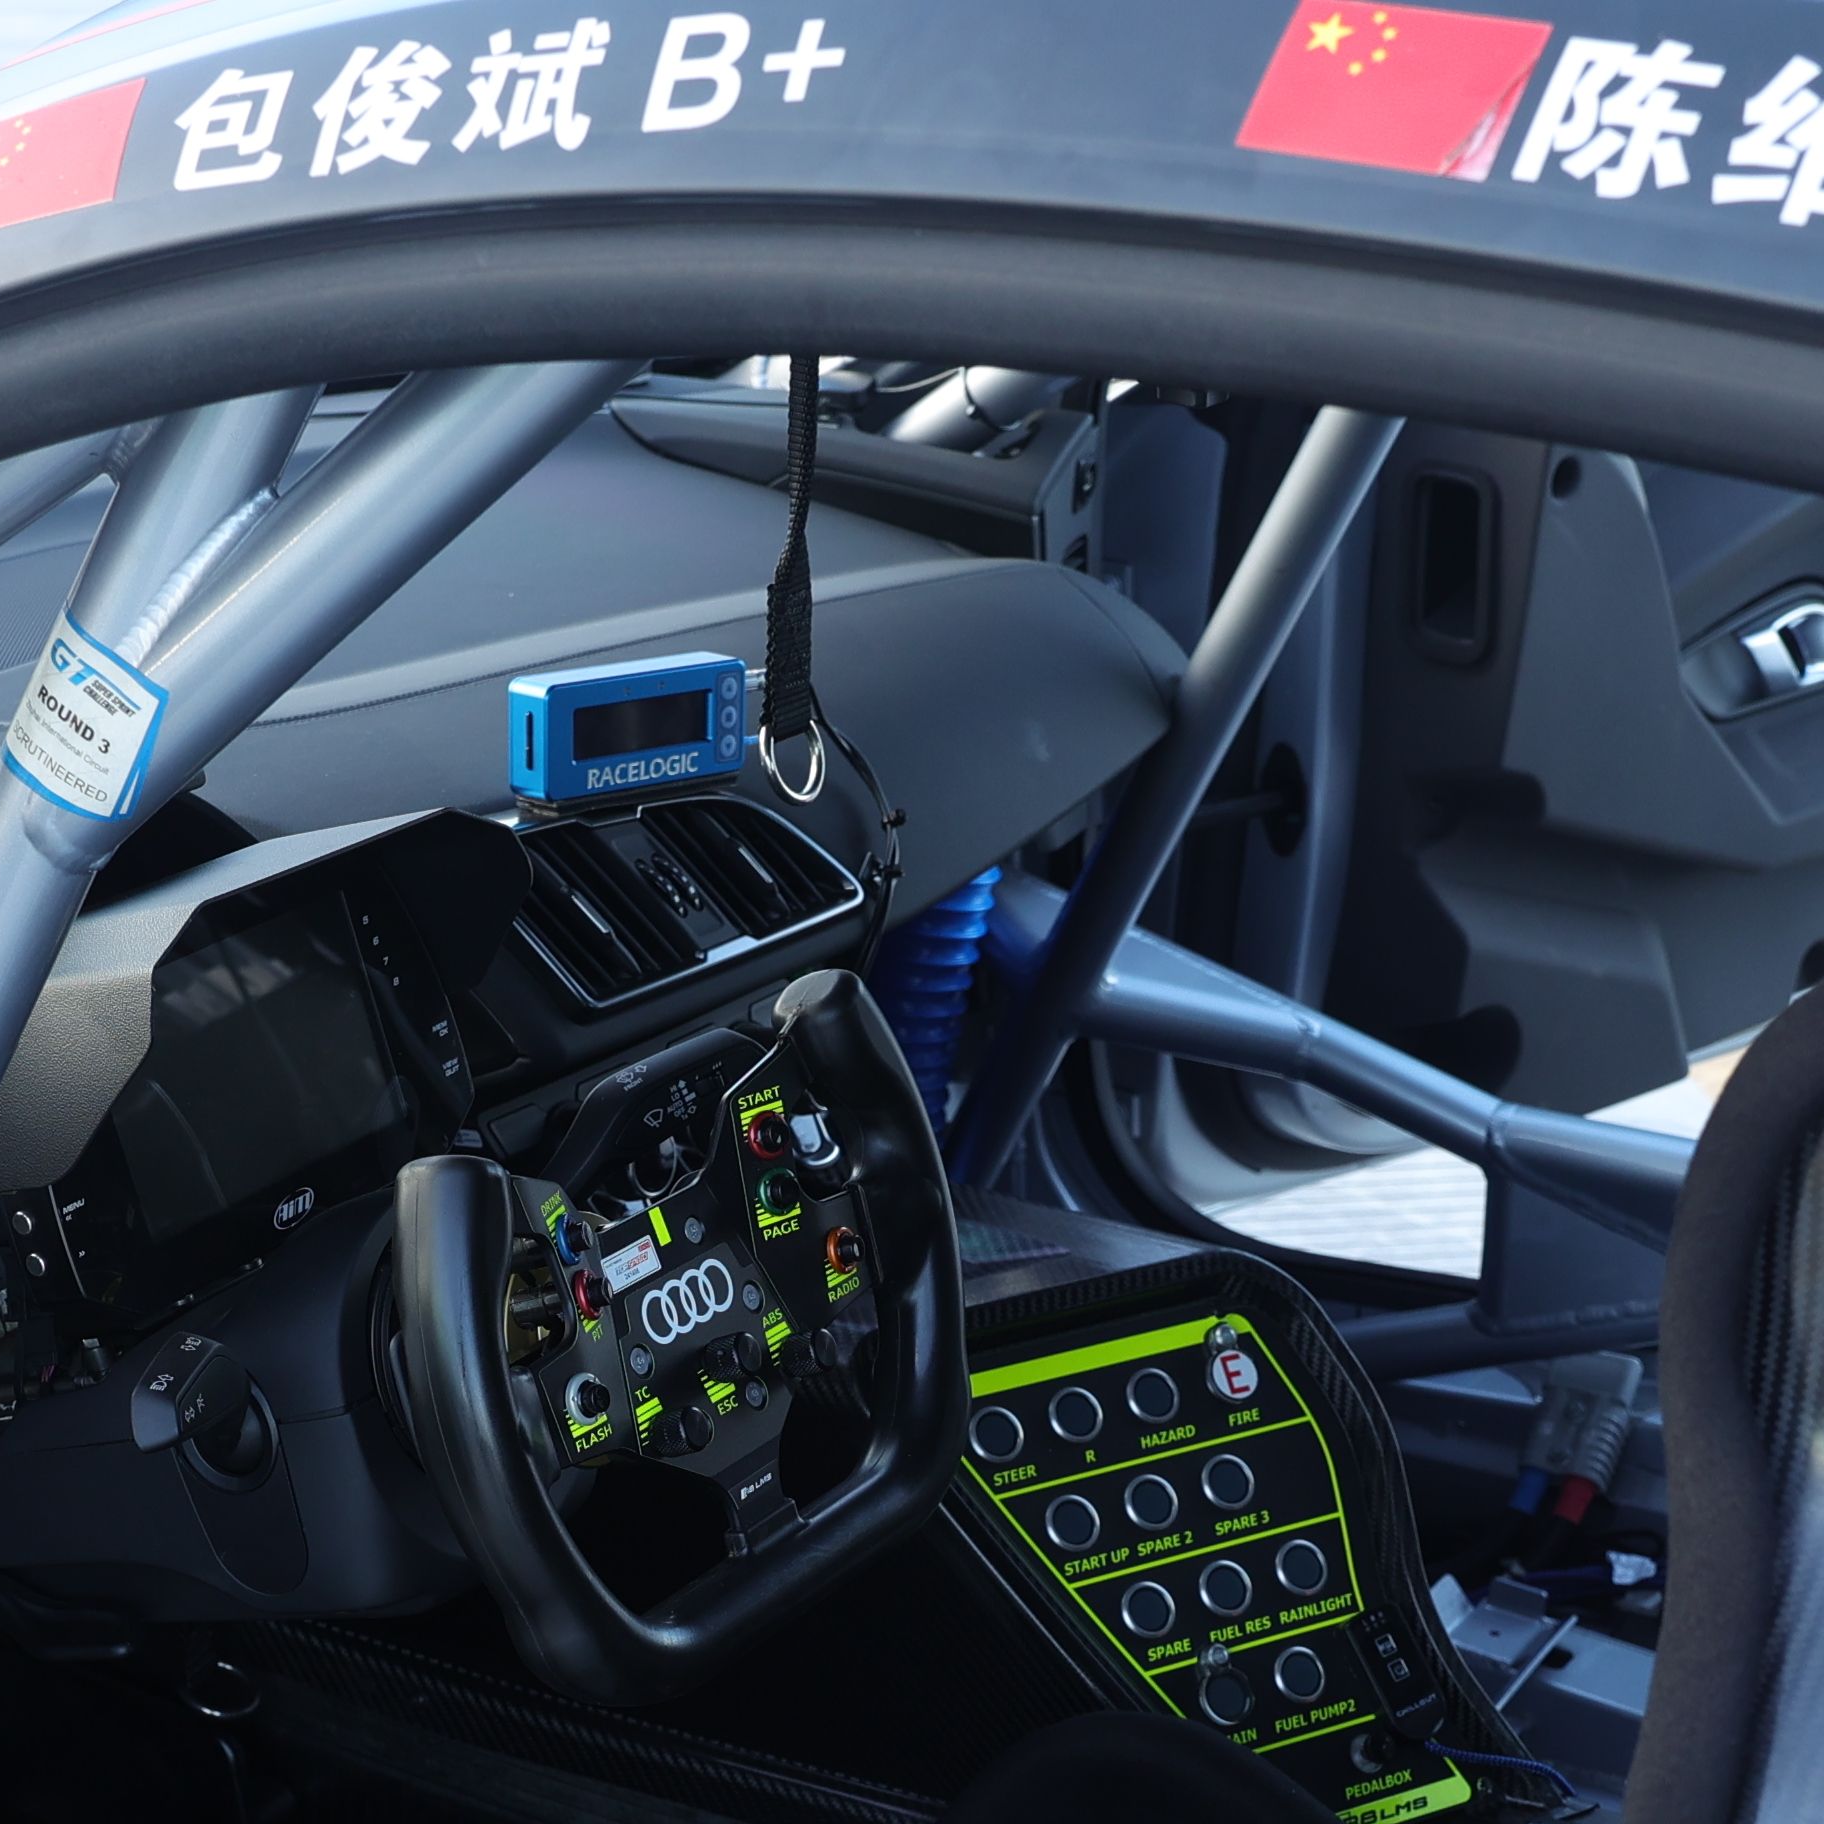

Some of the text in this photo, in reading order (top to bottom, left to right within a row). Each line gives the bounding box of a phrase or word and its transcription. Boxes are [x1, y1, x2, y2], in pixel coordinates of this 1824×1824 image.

[173, 11, 847, 192] 包俊斌 B+
[50, 637, 97, 687] GT
[83, 686, 118, 716] CHALLENGE
[91, 680, 136, 718] SUPER SPRINT
[37, 685, 111, 754] ROUND 3
[42, 710, 83, 757] International
[83, 752, 110, 775] Circuit
[13, 719, 109, 804] SCRUTINEERED
[587, 752, 699, 790] RACELOGIC
[363, 915, 369, 925] 5
[373, 936, 379, 946] 6
[383, 956, 389, 966] 7
[393, 976, 399, 986] 8
[667, 1100, 683, 1113] AUTO
[671, 1092, 680, 1101] LO
[738, 1086, 781, 1109] START
[63, 1198, 85, 1214] MENU
[541, 1189, 564, 1218] DRINK
[762, 1218, 801, 1241] PAGE
[827, 1276, 861, 1302] RADIO
[762, 1309, 784, 1328] ABS
[592, 1324, 604, 1343] PIT
[1221, 1353, 1250, 1395] E
[635, 1386, 651, 1401] TC
[717, 1395, 740, 1416] ESC
[1228, 1409, 1260, 1427] FIRE
[575, 1423, 613, 1453] FLASH
[1140, 1424, 1197, 1450] HAZARD
[1086, 1449, 1096, 1464] R
[993, 1464, 1037, 1487] STEER
[1214, 1510, 1270, 1537] SPARE 3
[1137, 1531, 1194, 1557] SPARE 2
[1064, 1546, 1130, 1577] START UP
[1279, 1593, 1353, 1625] RAINLIGHT
[1209, 1616, 1272, 1644] FUEL RES
[1147, 1638, 1192, 1661] SPARE
[1275, 1698, 1357, 1734] FUEL PUMP2
[1227, 1727, 1258, 1745] AIN
[1344, 1769, 1413, 1800] PEDALBOX
[1380, 1796, 1428, 1822] LMS
